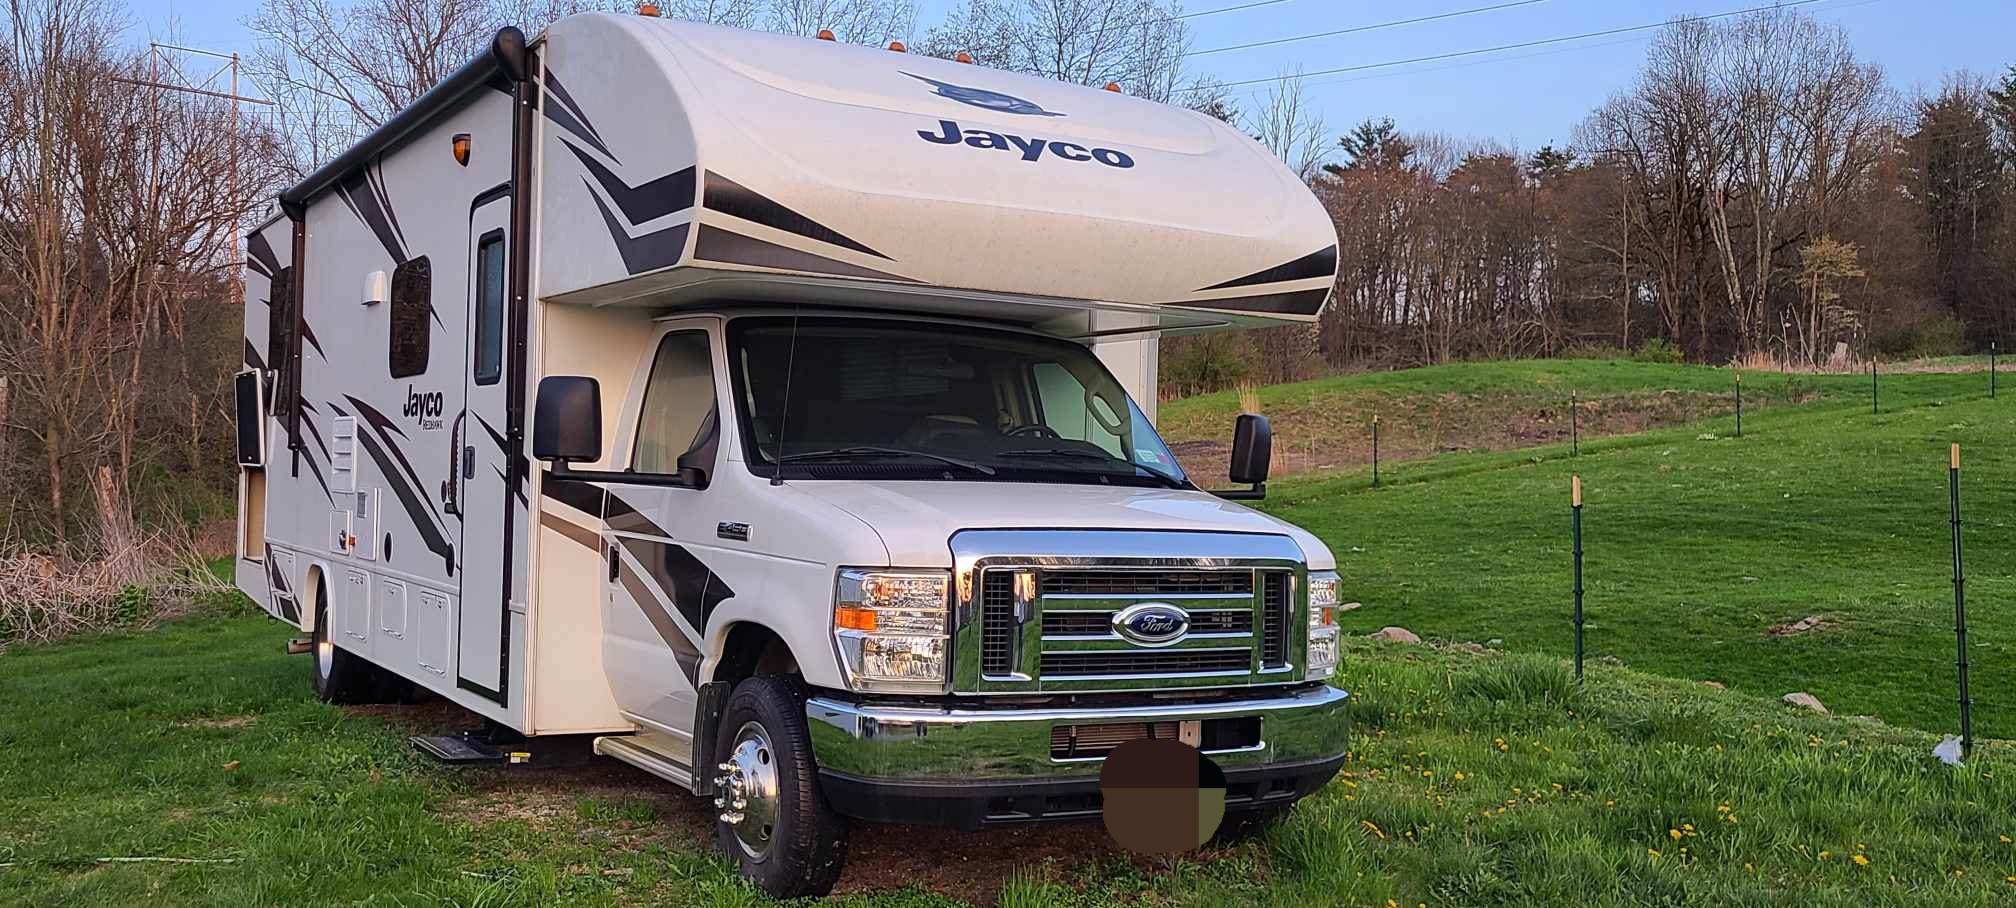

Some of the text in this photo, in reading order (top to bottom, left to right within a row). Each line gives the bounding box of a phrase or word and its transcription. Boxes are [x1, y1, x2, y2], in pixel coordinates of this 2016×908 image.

[917, 119, 1135, 168] Jayco
[403, 384, 443, 425] Jayco
[1140, 614, 1174, 632] Ford
